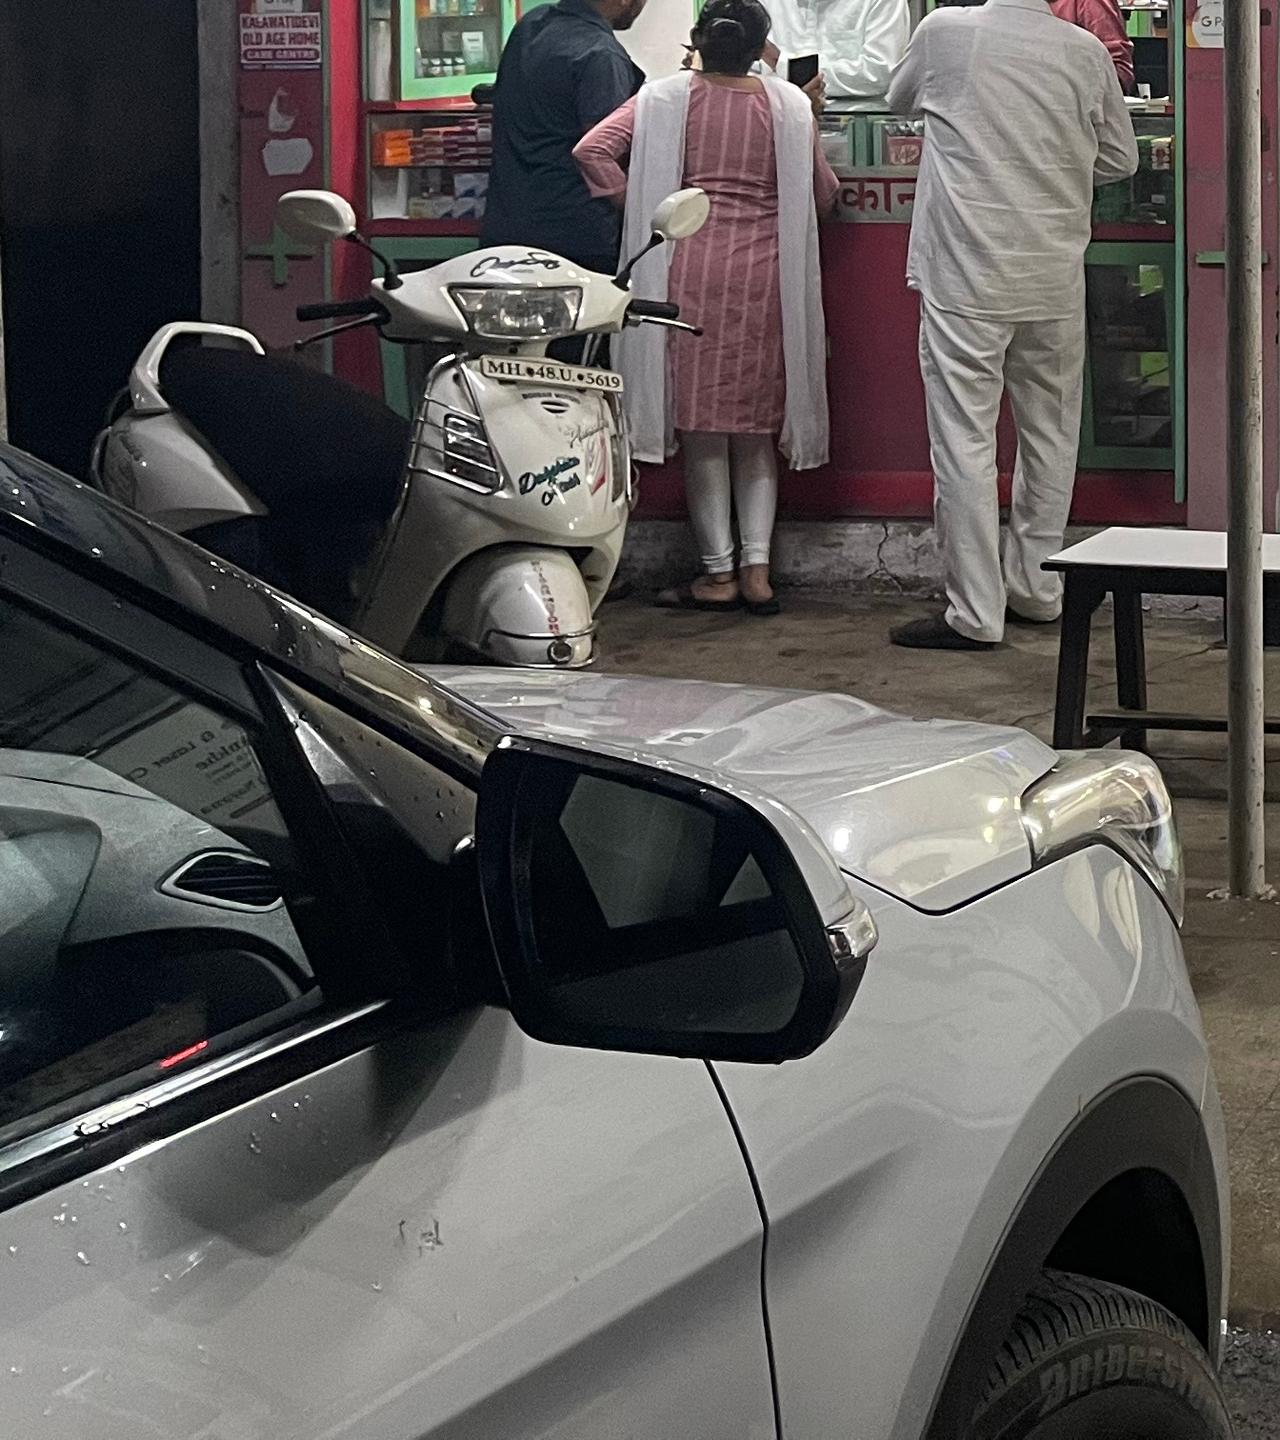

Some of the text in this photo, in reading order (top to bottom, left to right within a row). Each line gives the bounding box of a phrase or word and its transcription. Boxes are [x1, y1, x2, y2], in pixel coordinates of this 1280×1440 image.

[242, 32, 320, 46] OLD AGE HOME
[585, 373, 621, 389] 5619
